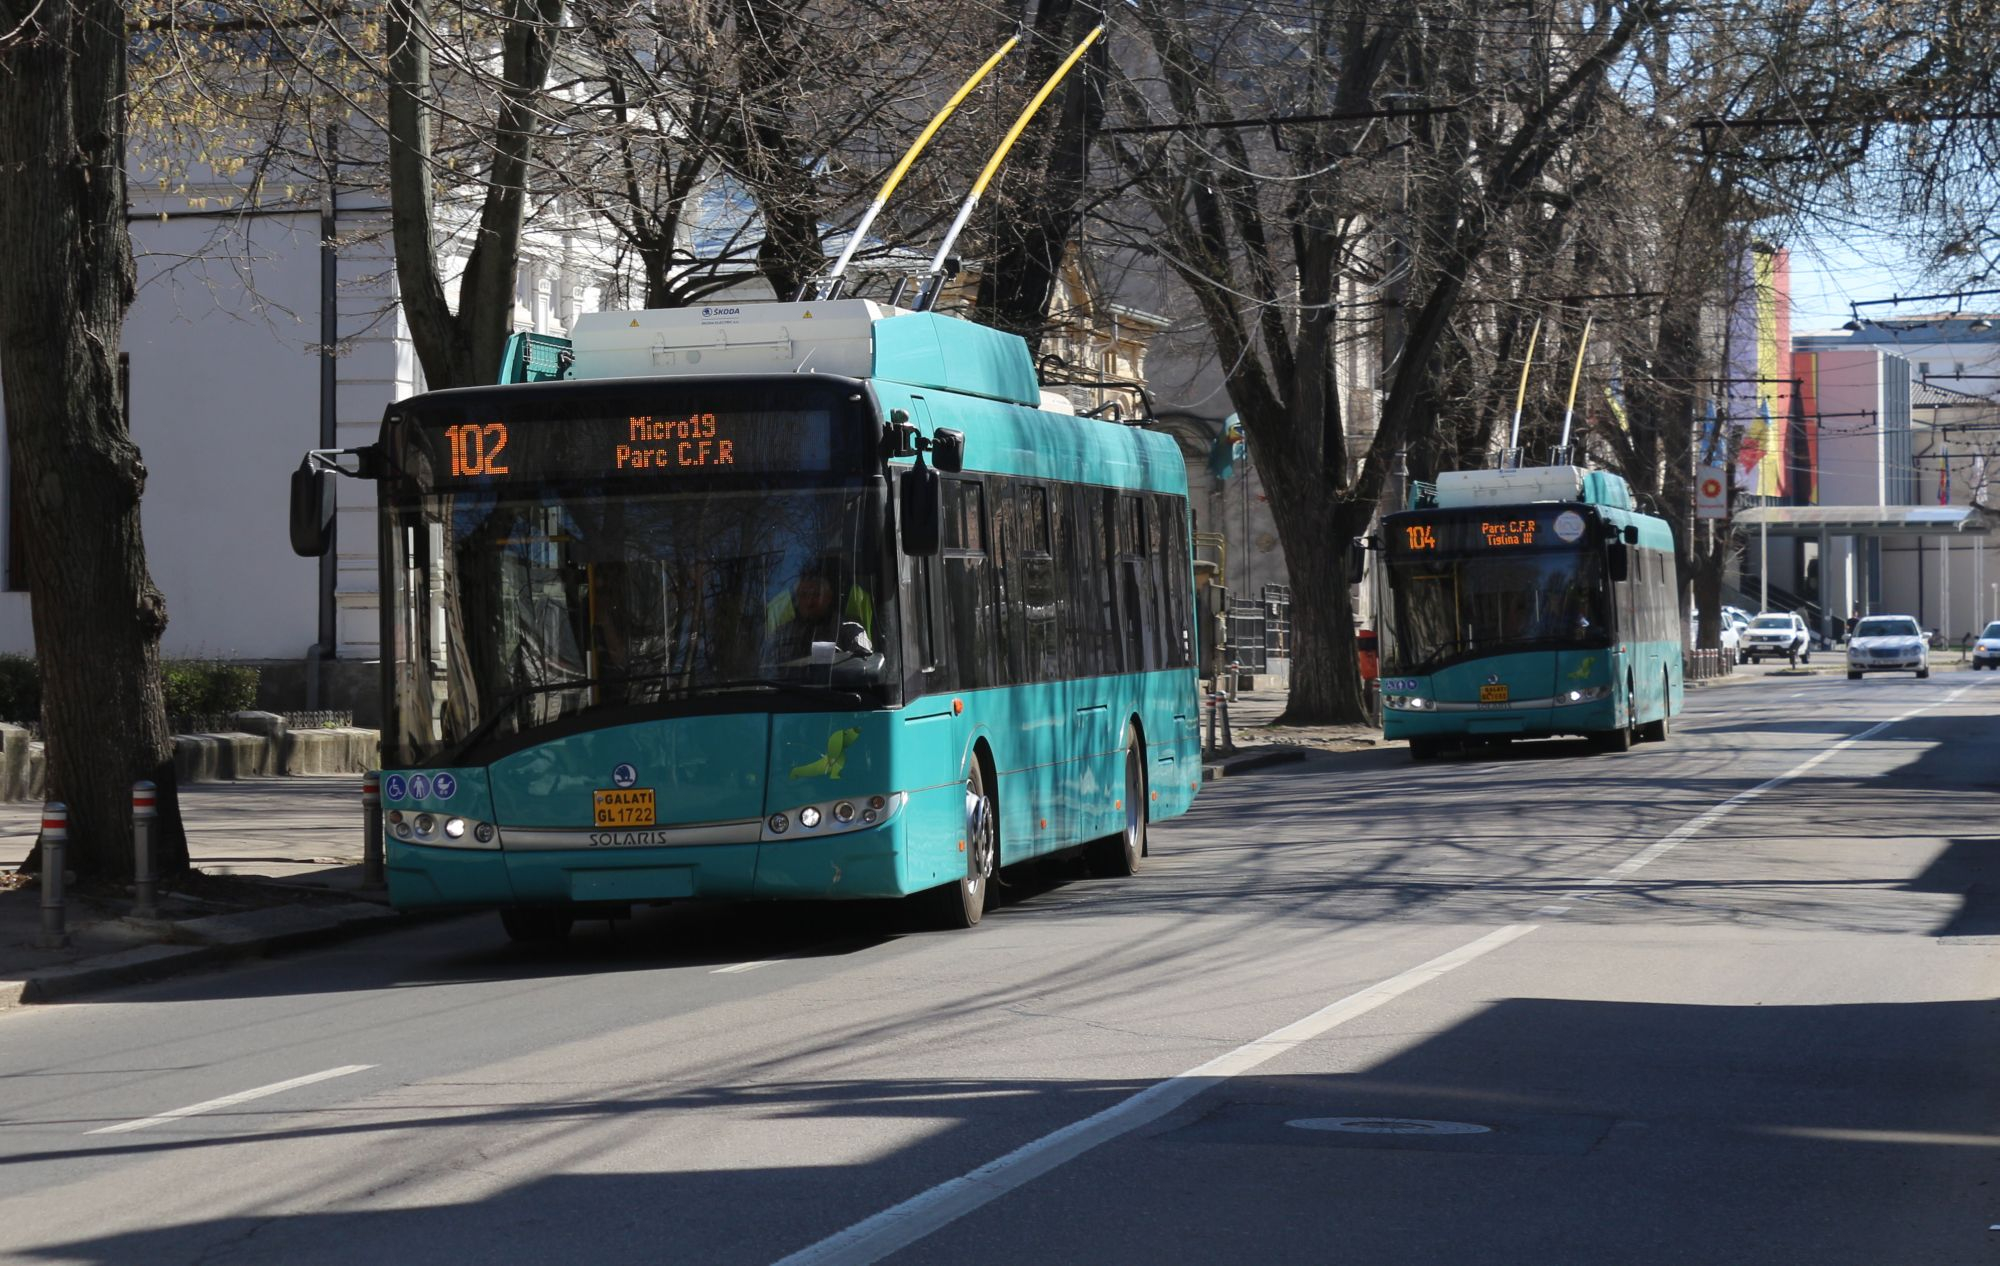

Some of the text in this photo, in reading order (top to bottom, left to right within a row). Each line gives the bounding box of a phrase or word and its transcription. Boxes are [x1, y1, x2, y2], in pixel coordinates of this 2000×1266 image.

[630, 413, 716, 441] Micro19
[444, 423, 509, 476] 102
[616, 440, 734, 469] Parc C.F.R
[1406, 525, 1436, 550] 104
[1482, 520, 1536, 535] Parc C.F.R
[605, 793, 653, 804] GALATI
[598, 807, 652, 822] GL 1722
[589, 832, 666, 847] SOLARIS
